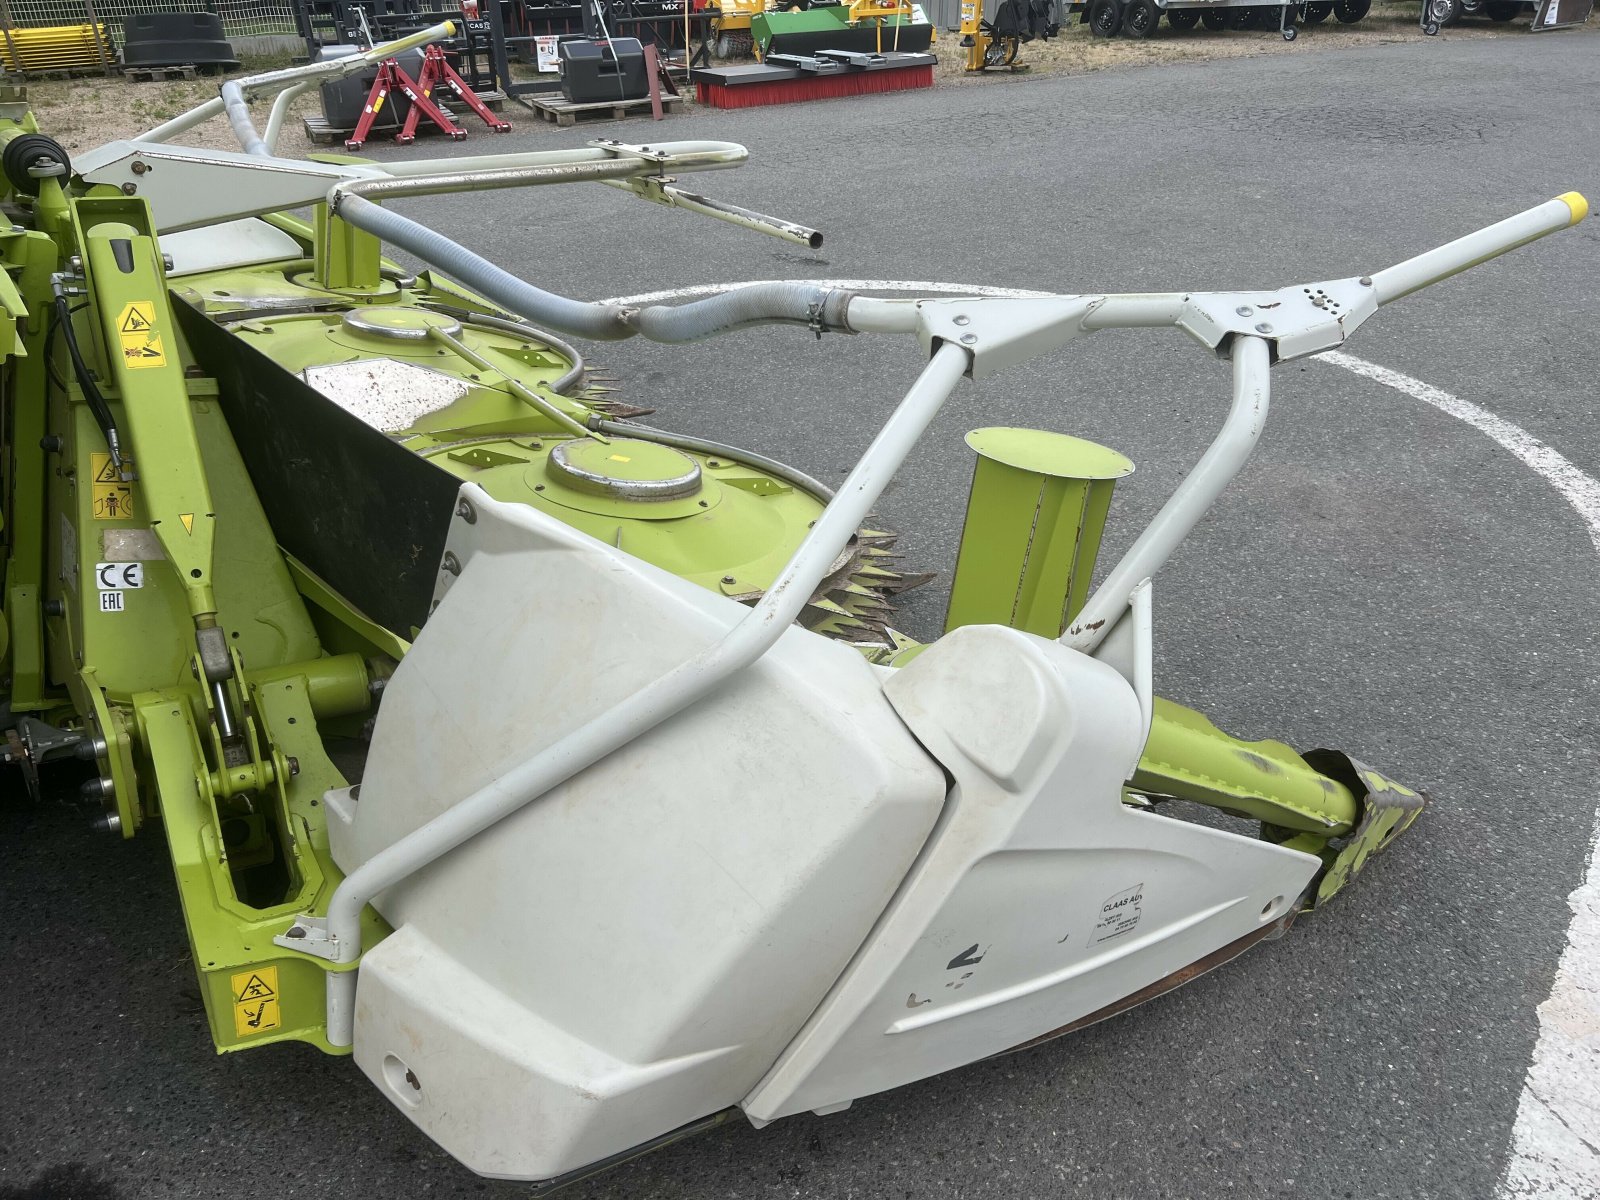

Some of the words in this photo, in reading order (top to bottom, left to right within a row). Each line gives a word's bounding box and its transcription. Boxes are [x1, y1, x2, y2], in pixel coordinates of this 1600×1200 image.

[101, 564, 138, 587] CE
[102, 592, 122, 610] EAC
[1103, 898, 1129, 912] CLAAS
